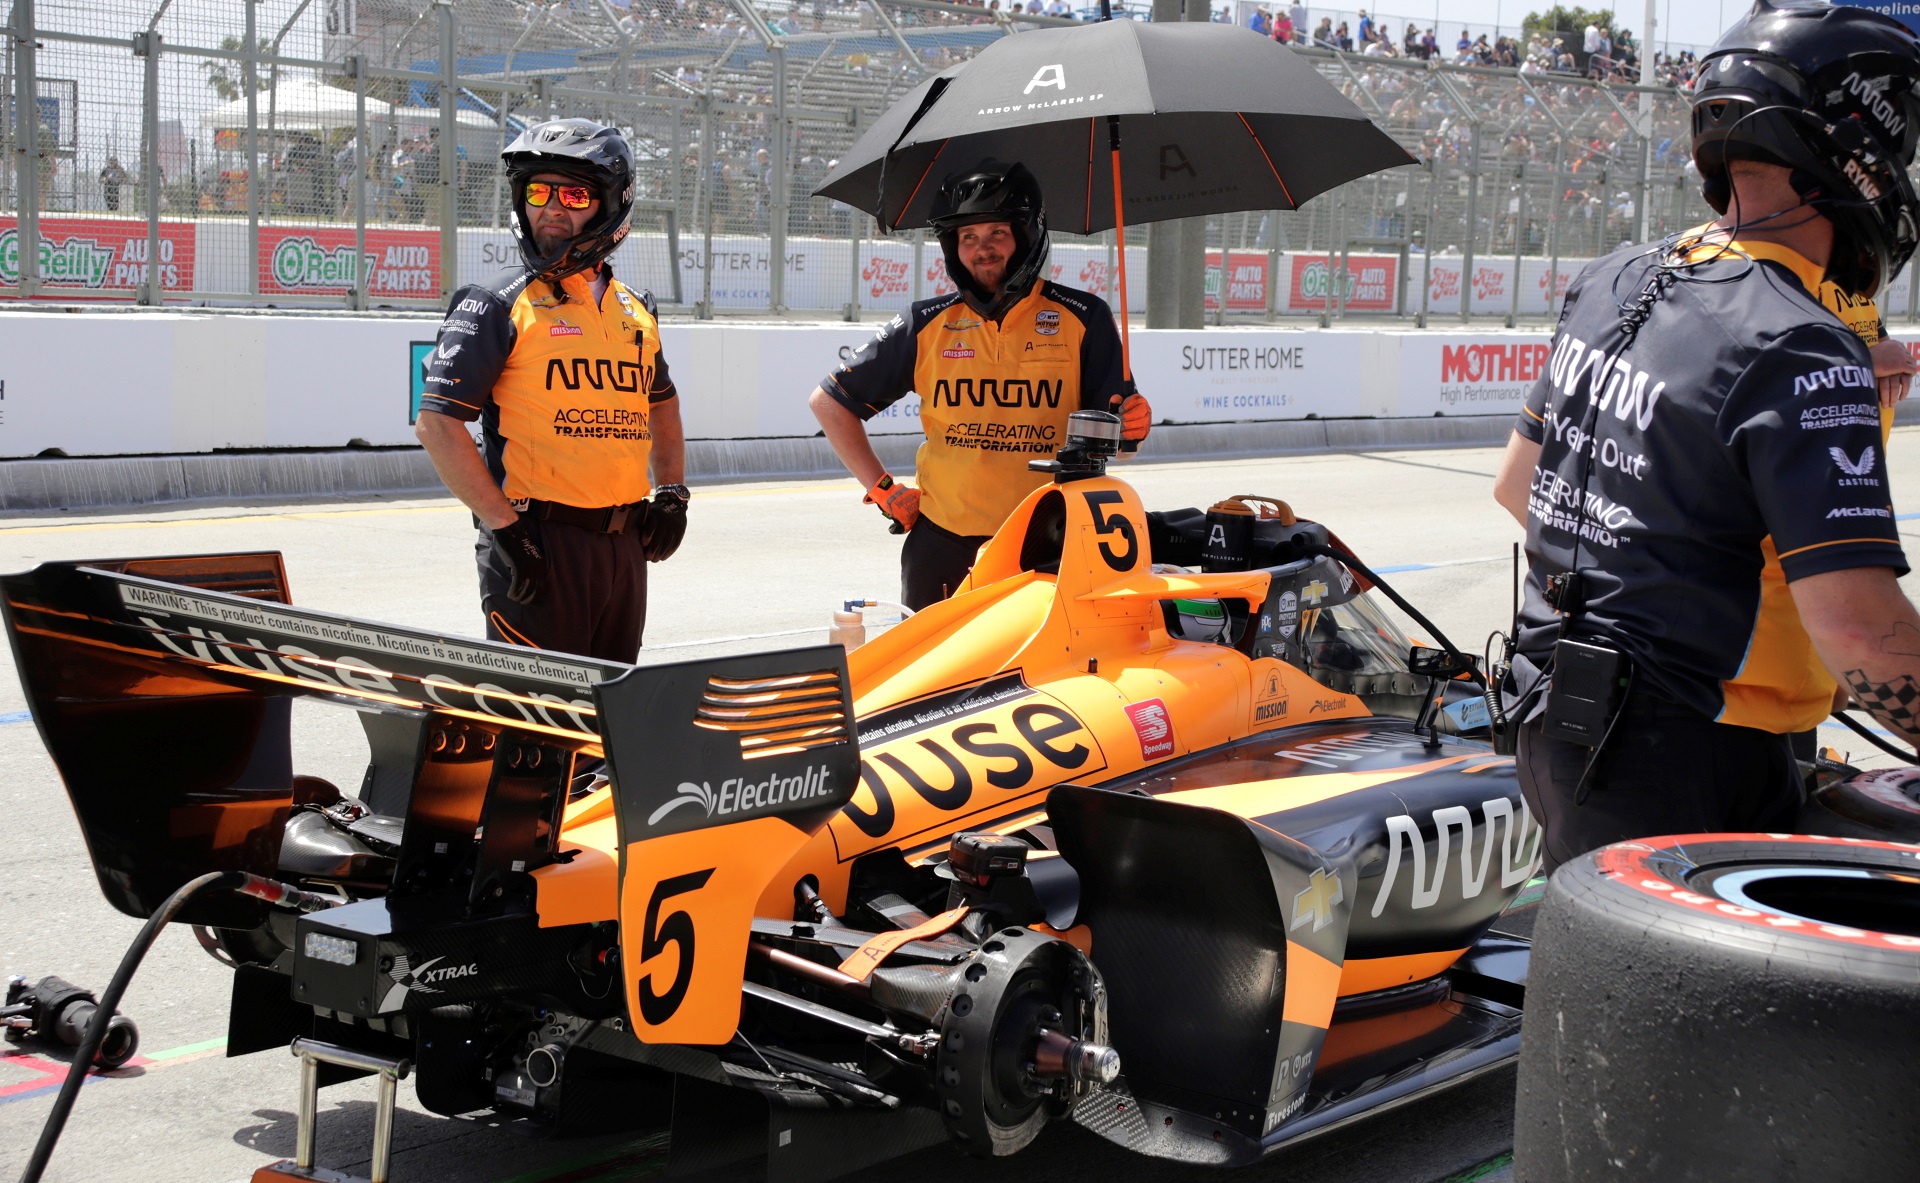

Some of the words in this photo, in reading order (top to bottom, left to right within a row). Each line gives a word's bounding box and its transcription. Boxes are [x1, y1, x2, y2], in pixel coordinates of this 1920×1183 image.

[978, 104, 1022, 116] ARROW
[1027, 96, 1084, 111] McLAREN
[1089, 93, 1104, 102] SP
[1841, 72, 1906, 137] ARROW
[0, 234, 107, 284] OReilly
[383, 246, 430, 268] AUTO
[756, 253, 806, 272] HME
[862, 256, 909, 281] King
[377, 269, 432, 291] PARTS
[1235, 265, 1262, 282] AUTO
[1361, 268, 1386, 284] AUTO
[1050, 287, 1088, 312] Firestone
[1229, 284, 1264, 300] PARTS
[1356, 284, 1387, 300] PARTS
[1182, 345, 1250, 370] SUTTER
[1255, 347, 1304, 369] HOME
[1441, 344, 1552, 383] MOTHER
[1793, 365, 1876, 396] ARROW
[933, 378, 1063, 409] ARROW
[1203, 396, 1229, 408] WINE
[1233, 394, 1287, 407] COCKTAILS
[1440, 385, 1462, 406] High
[1464, 383, 1521, 402] Performance
[554, 408, 648, 427] ACCELERATIN
[1800, 403, 1879, 421] ACCELERATING
[1600, 437, 1647, 481] Out
[1838, 478, 1880, 487] CASTORE
[1531, 464, 1633, 530] CELERATING
[1825, 506, 1890, 519] McLaren
[1081, 490, 1138, 573] 5
[127, 587, 193, 612] WARNING:
[192, 599, 219, 617] This
[220, 606, 267, 627] product
[267, 618, 320, 637] contains
[320, 624, 375, 646] nicotine.
[376, 634, 431, 656] Nicotine
[433, 643, 446, 659] is
[448, 648, 464, 662] an
[466, 651, 526, 672] addictive
[529, 658, 594, 684] chemical.
[884, 717, 918, 734] nicotine.
[914, 706, 947, 725] Nicotine
[946, 706, 954, 716] is
[954, 703, 963, 714] an
[961, 695, 995, 711] addictive
[1143, 741, 1173, 756] Speedway
[717, 764, 830, 815] Electrolit
[1370, 793, 1543, 919] ARR
[637, 866, 718, 1026] 5
[423, 962, 479, 984] XTRAC
[1268, 1092, 1307, 1131] Firestone
